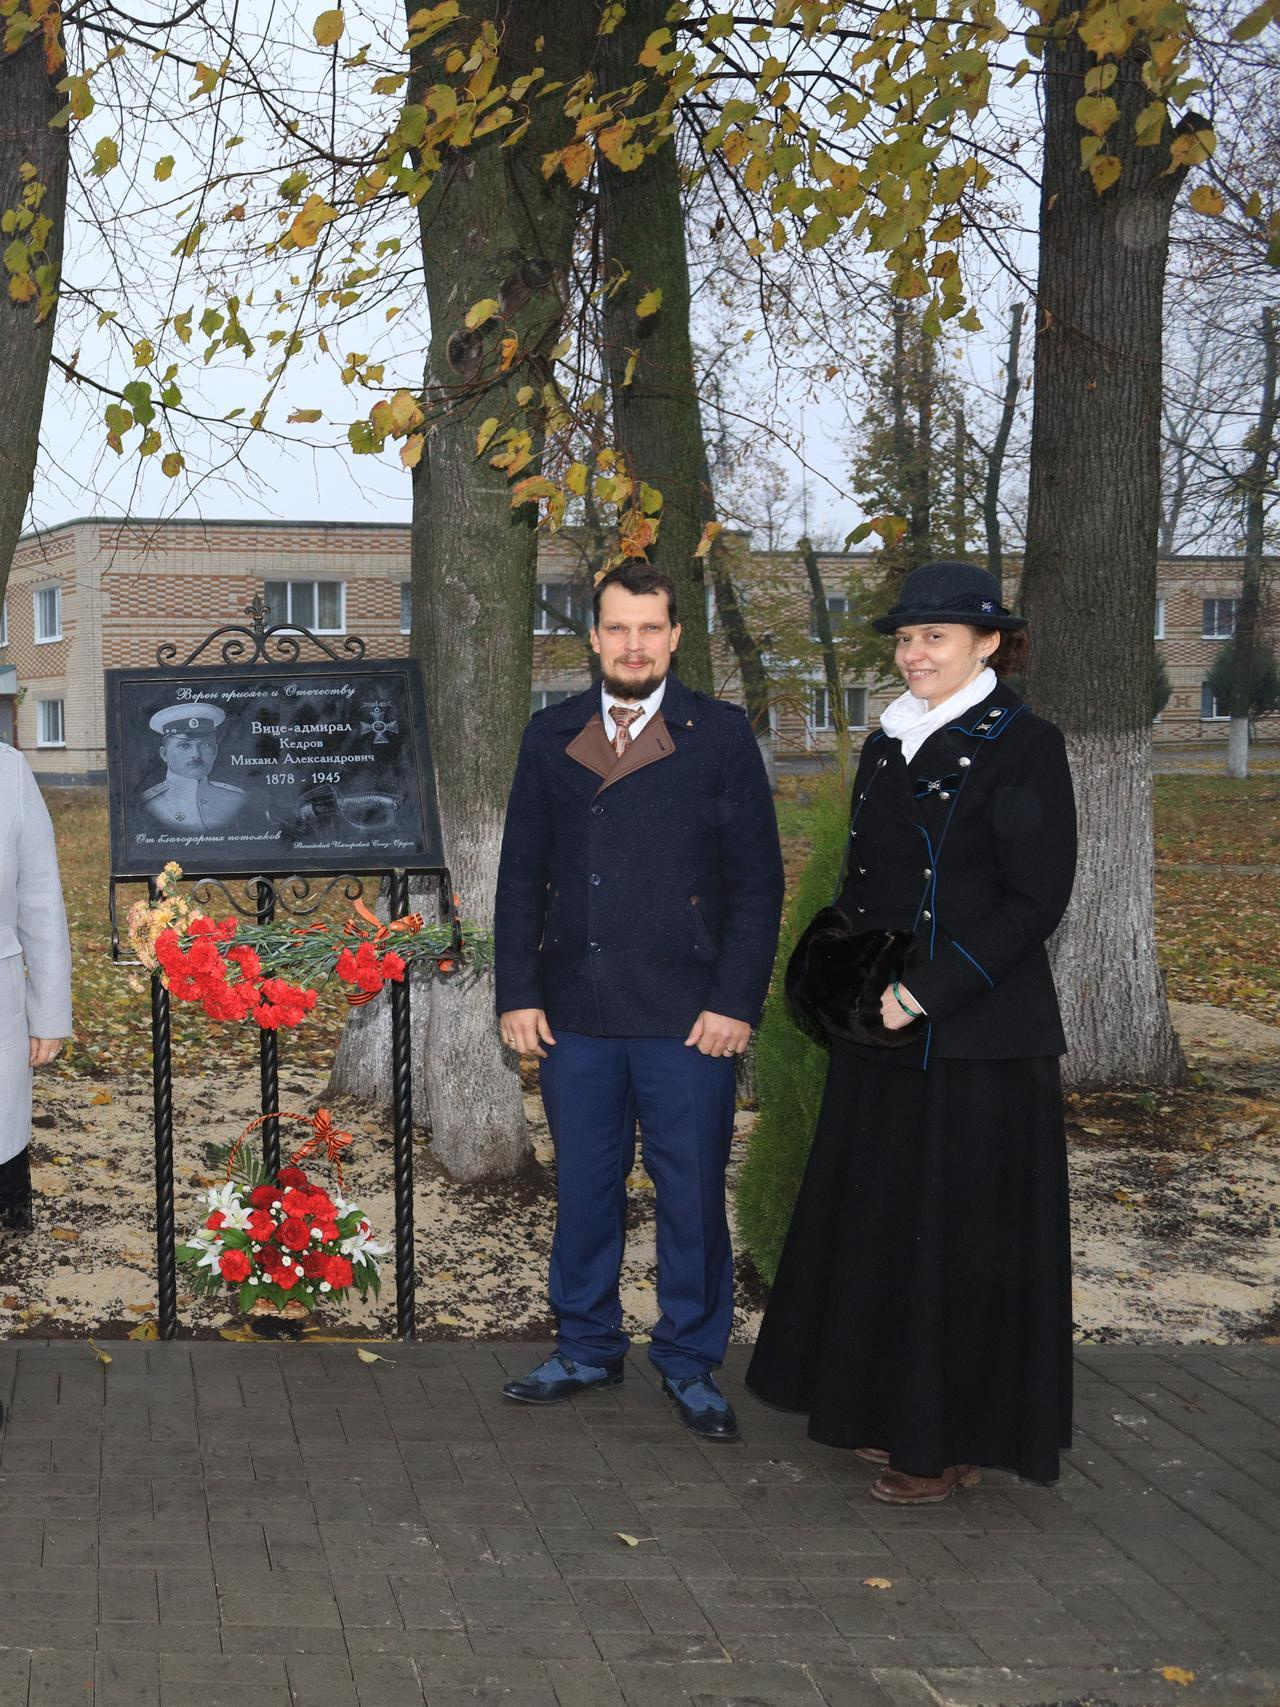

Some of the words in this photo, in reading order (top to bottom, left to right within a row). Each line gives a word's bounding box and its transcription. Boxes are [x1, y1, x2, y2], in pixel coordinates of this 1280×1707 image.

[176, 687, 218, 703] Верен
[220, 688, 269, 702] присяге
[272, 689, 280, 698] и
[284, 684, 356, 700] Отечеству
[251, 722, 353, 736] Вице-адмирал
[280, 738, 324, 750] Кедров
[231, 754, 278, 766] Михаил
[284, 753, 375, 766] Александрович
[265, 774, 295, 785] 1878
[312, 772, 341, 784] 1945
[136, 834, 154, 844] От
[158, 833, 224, 847] благодарных
[228, 831, 281, 843] потомков
